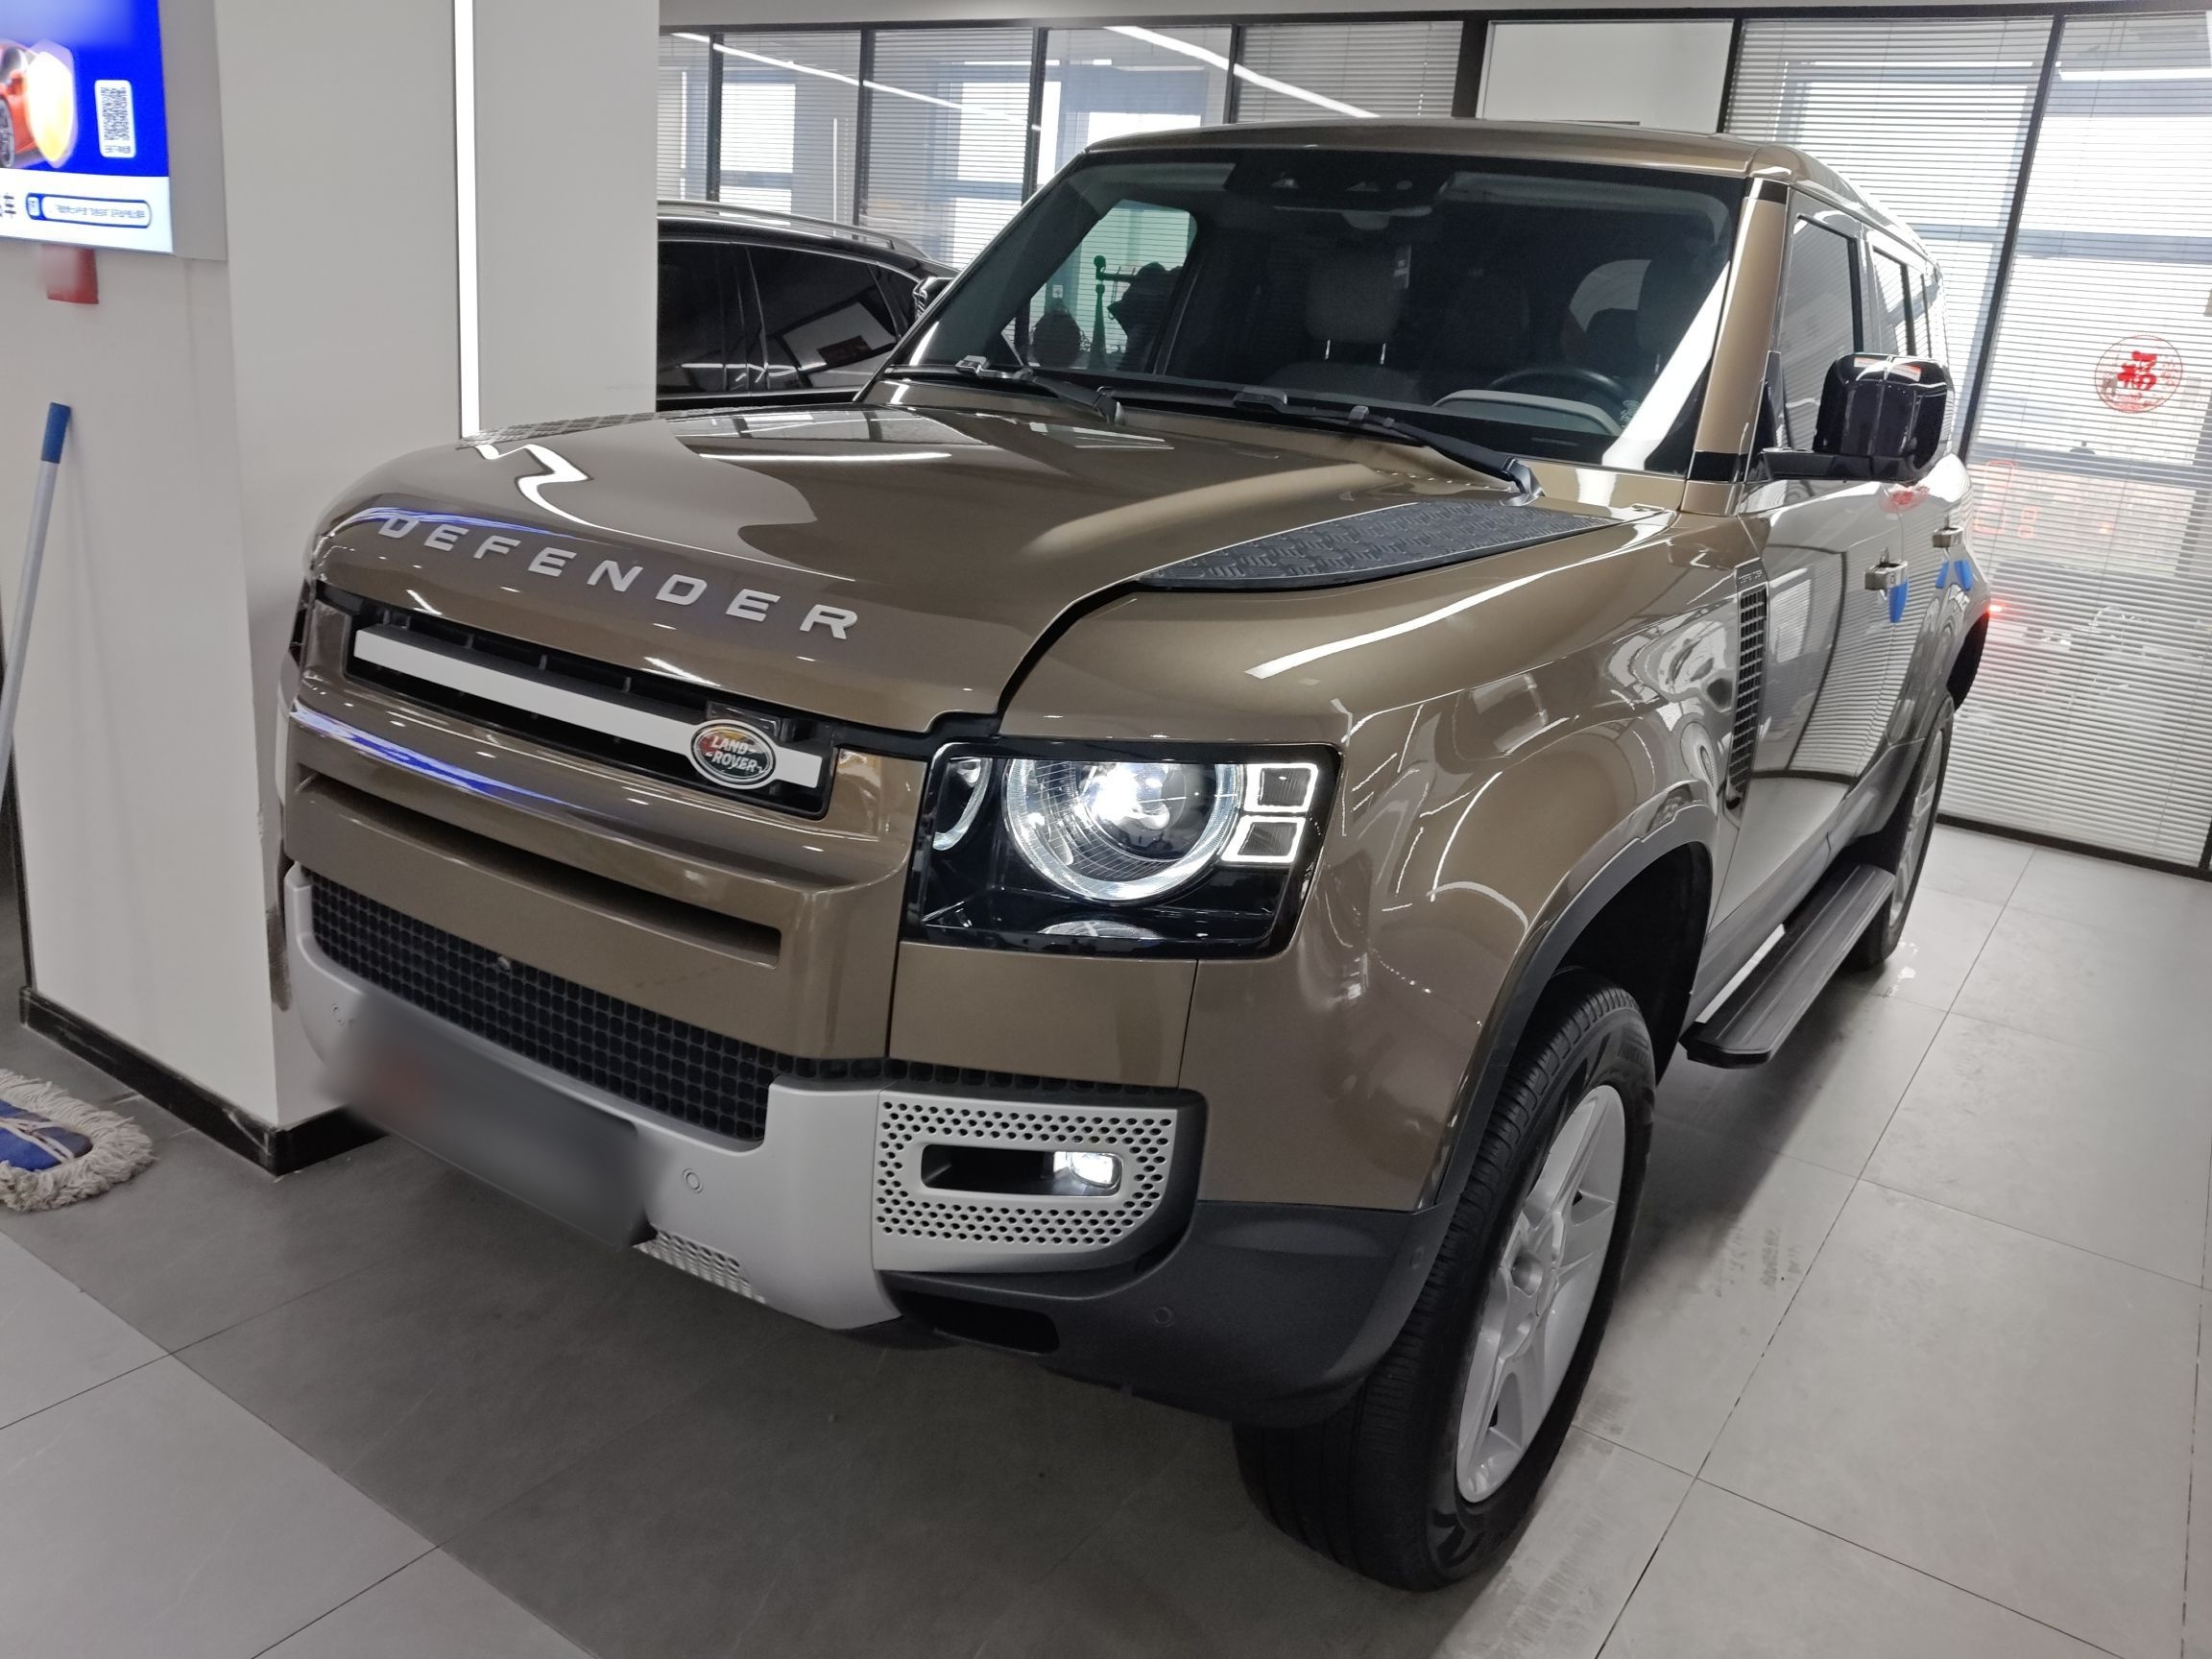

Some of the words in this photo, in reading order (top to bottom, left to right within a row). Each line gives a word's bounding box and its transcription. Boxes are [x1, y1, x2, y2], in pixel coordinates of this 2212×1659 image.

[378, 514, 858, 639] DEFENDER
[710, 735, 749, 755] LAND
[711, 750, 757, 773] ROVER
